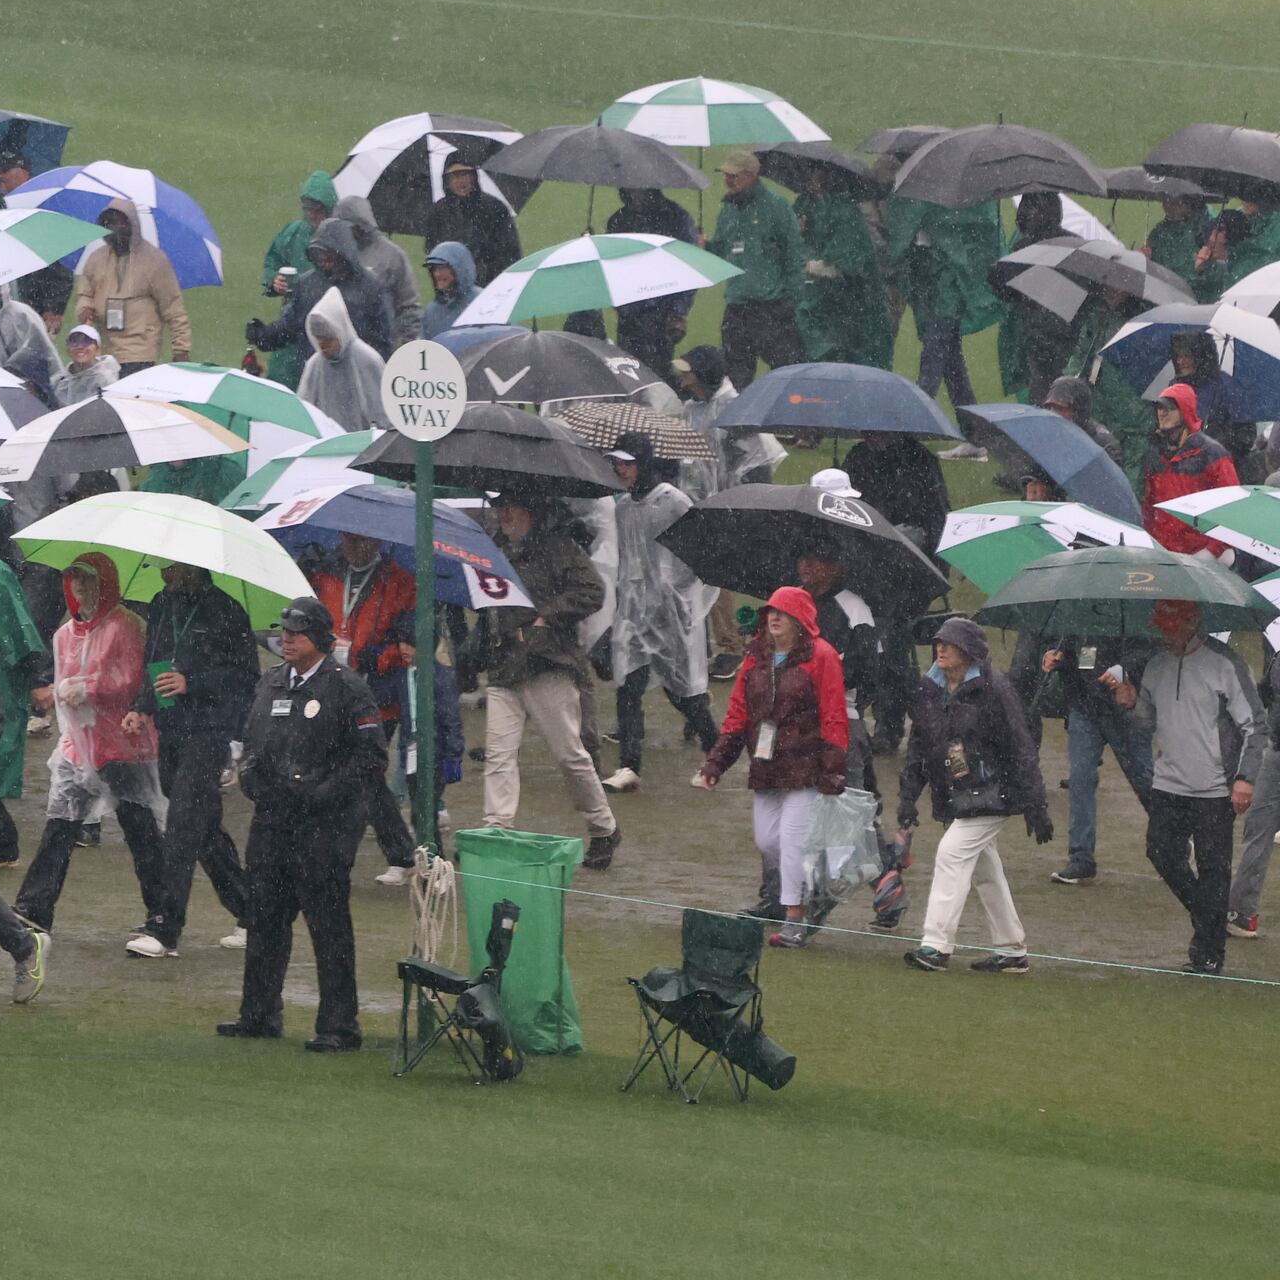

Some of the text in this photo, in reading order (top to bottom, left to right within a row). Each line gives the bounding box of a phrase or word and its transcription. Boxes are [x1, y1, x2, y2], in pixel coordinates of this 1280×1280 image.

[419, 349, 430, 371] 1
[391, 375, 458, 400] CROSS
[398, 403, 452, 428] WAY
[432, 540, 492, 568] TIGERS
